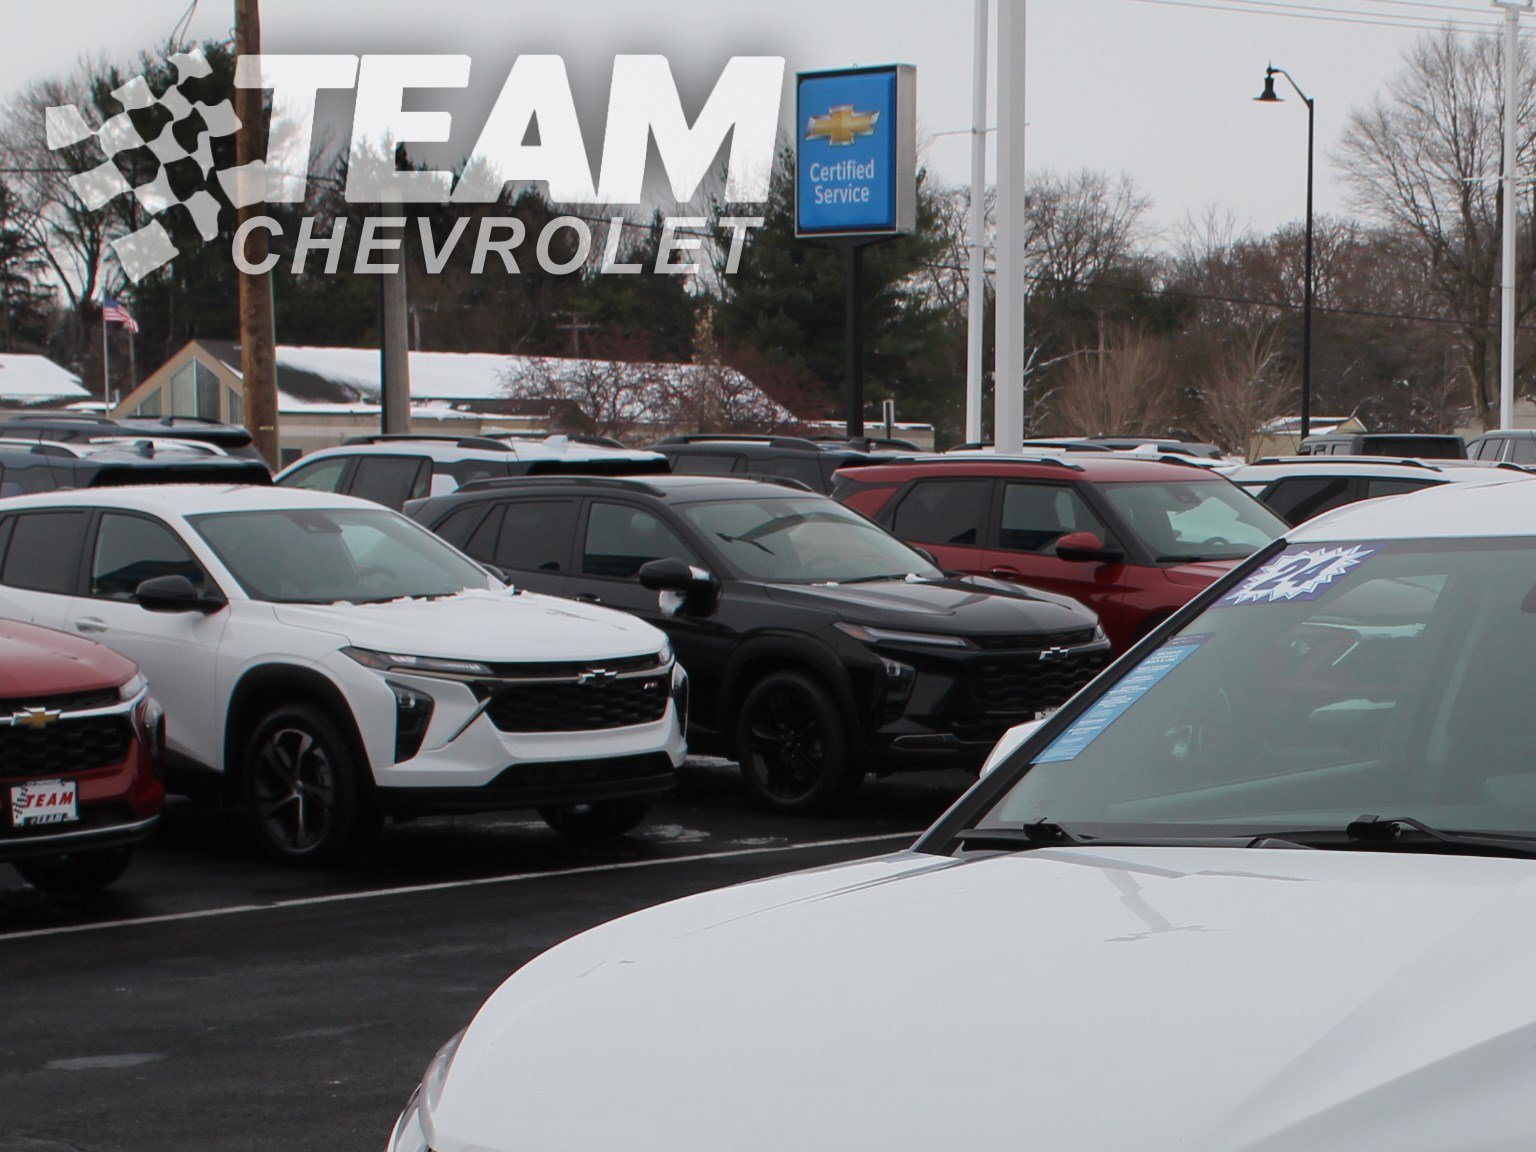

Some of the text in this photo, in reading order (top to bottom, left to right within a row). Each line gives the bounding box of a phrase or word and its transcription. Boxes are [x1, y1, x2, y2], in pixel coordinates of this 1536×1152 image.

[809, 158, 875, 182] Certified
[814, 183, 870, 204] Service
[1250, 556, 1343, 591] 24
[25, 791, 74, 808] TEAM
